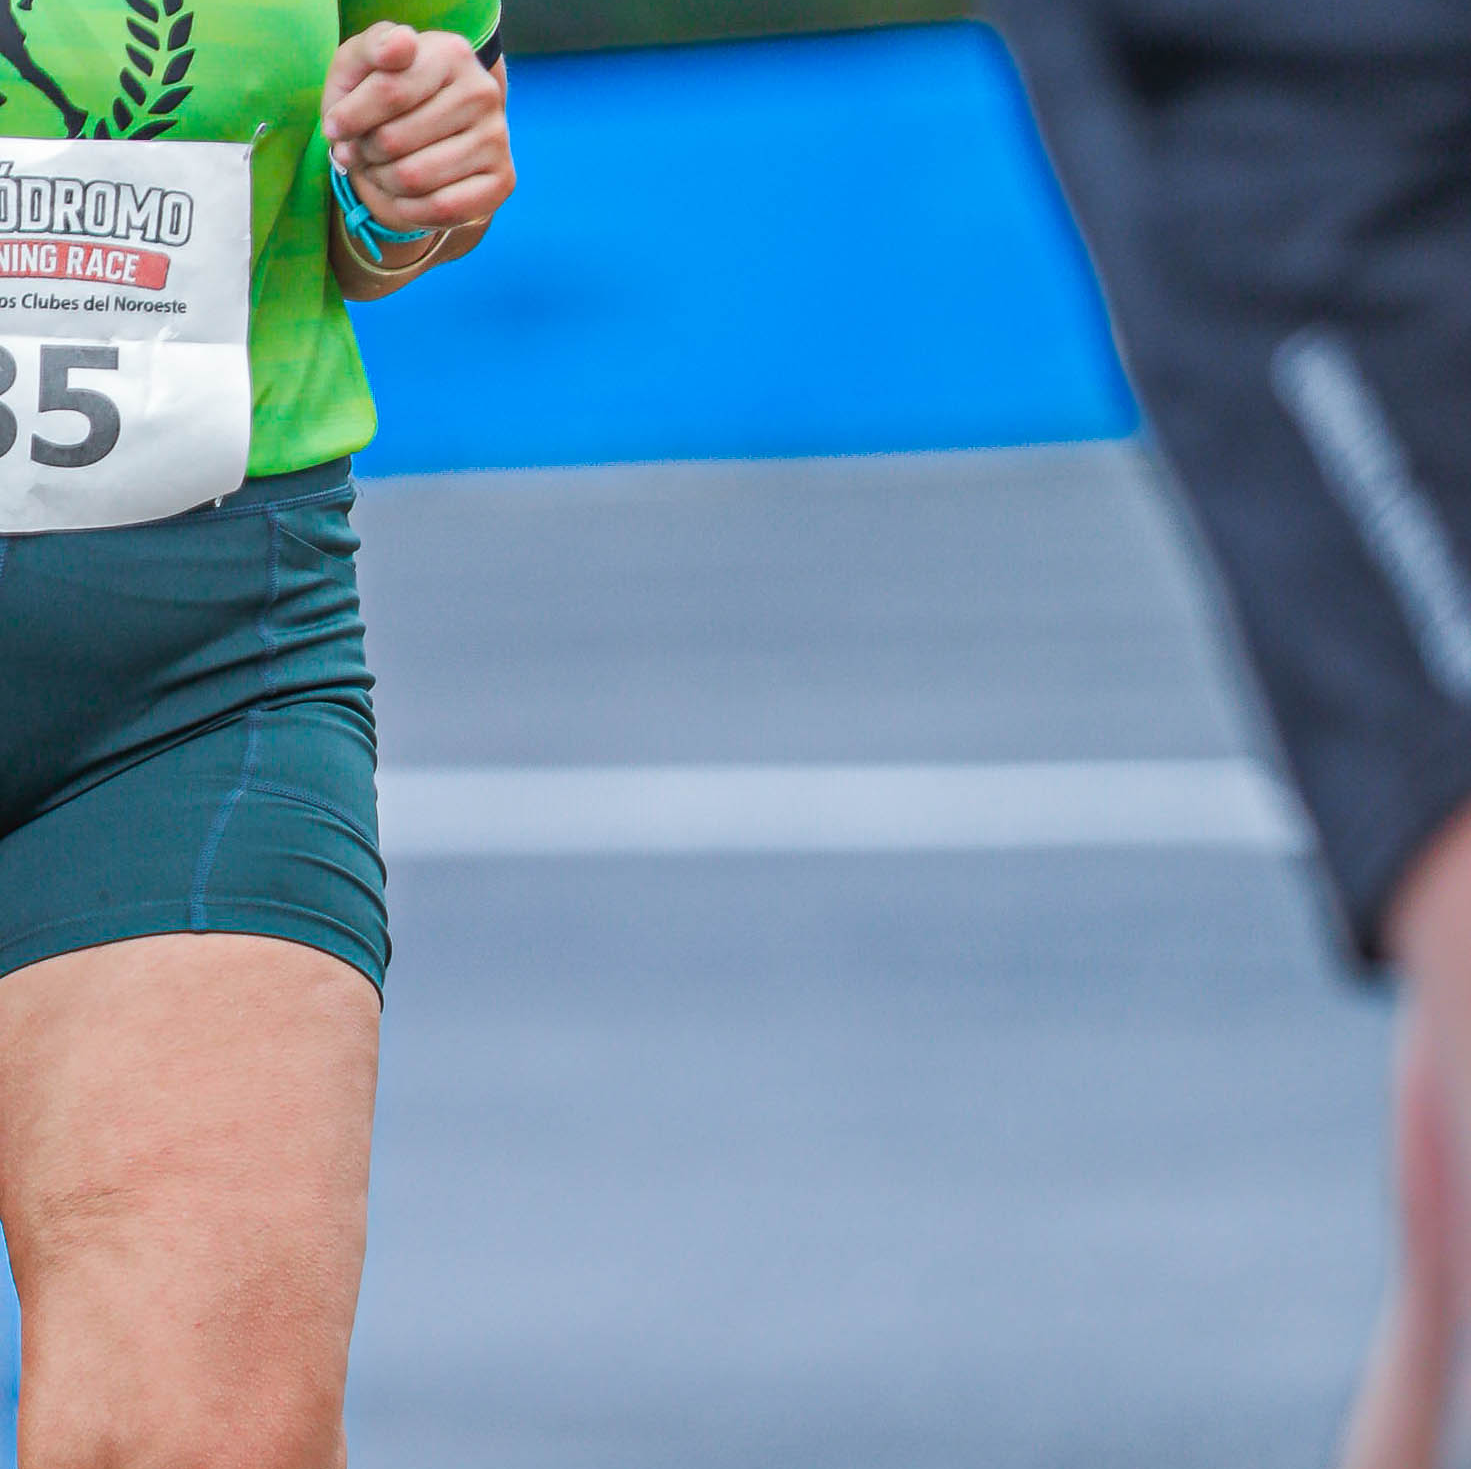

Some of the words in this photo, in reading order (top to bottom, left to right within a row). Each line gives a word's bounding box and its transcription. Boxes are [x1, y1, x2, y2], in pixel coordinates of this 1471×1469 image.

[66, 245, 141, 283] RACE
[21, 292, 79, 310] Clubes
[83, 294, 109, 312] del
[114, 296, 187, 314] Noroeste
